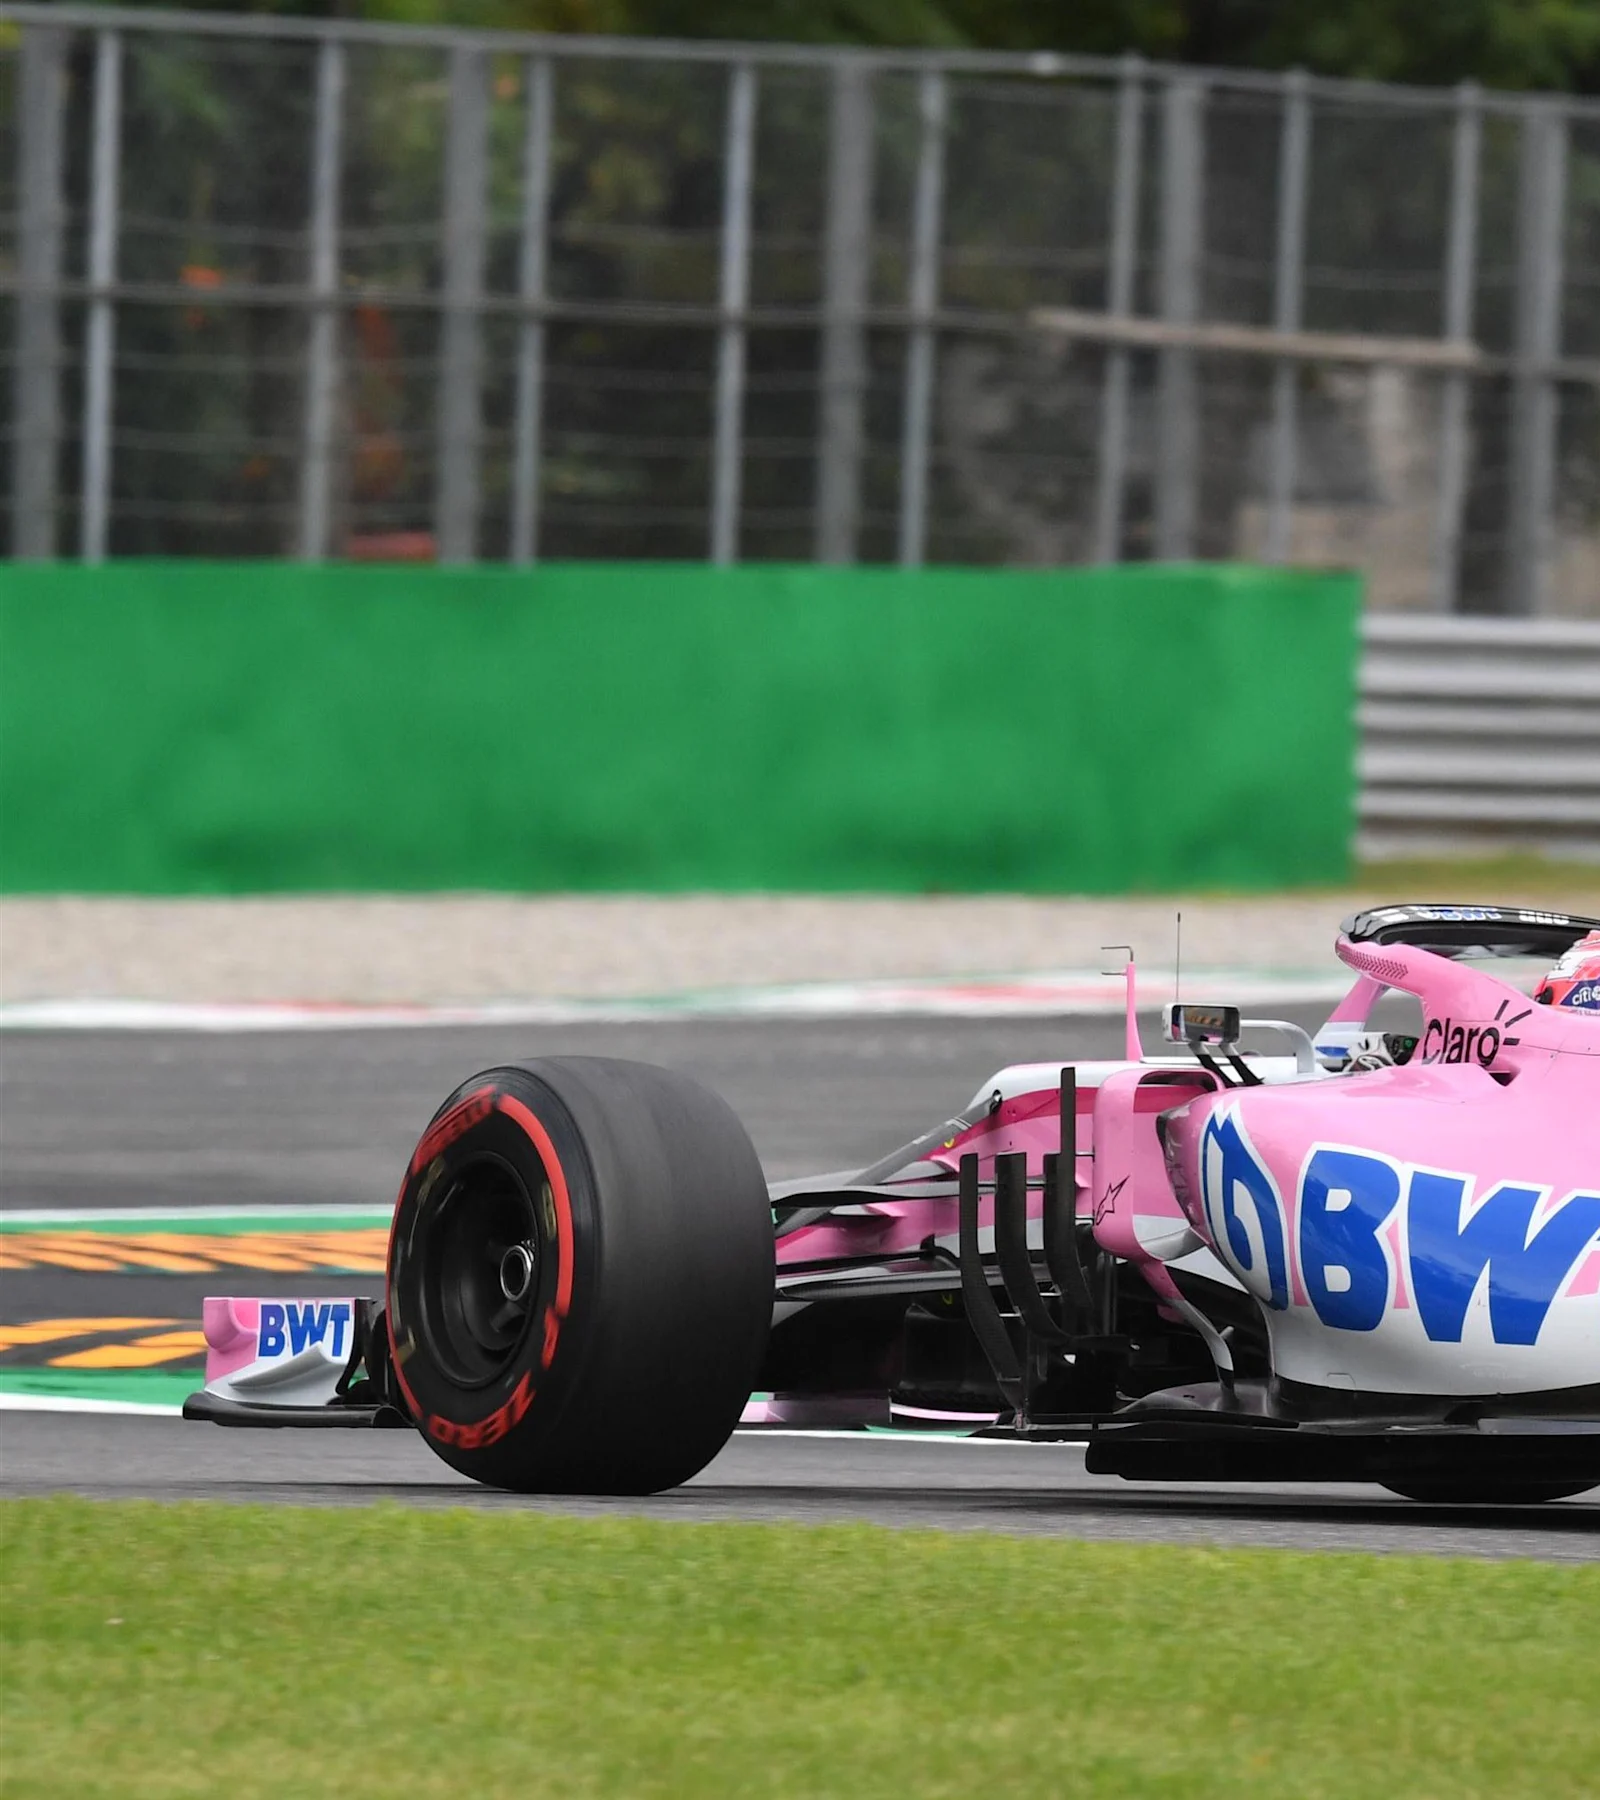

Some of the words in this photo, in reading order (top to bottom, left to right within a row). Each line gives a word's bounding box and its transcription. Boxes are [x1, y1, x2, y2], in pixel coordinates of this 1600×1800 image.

[1571, 986, 1593, 1006] citi
[1421, 1017, 1500, 1067] Claro
[258, 1304, 350, 1357] BWT
